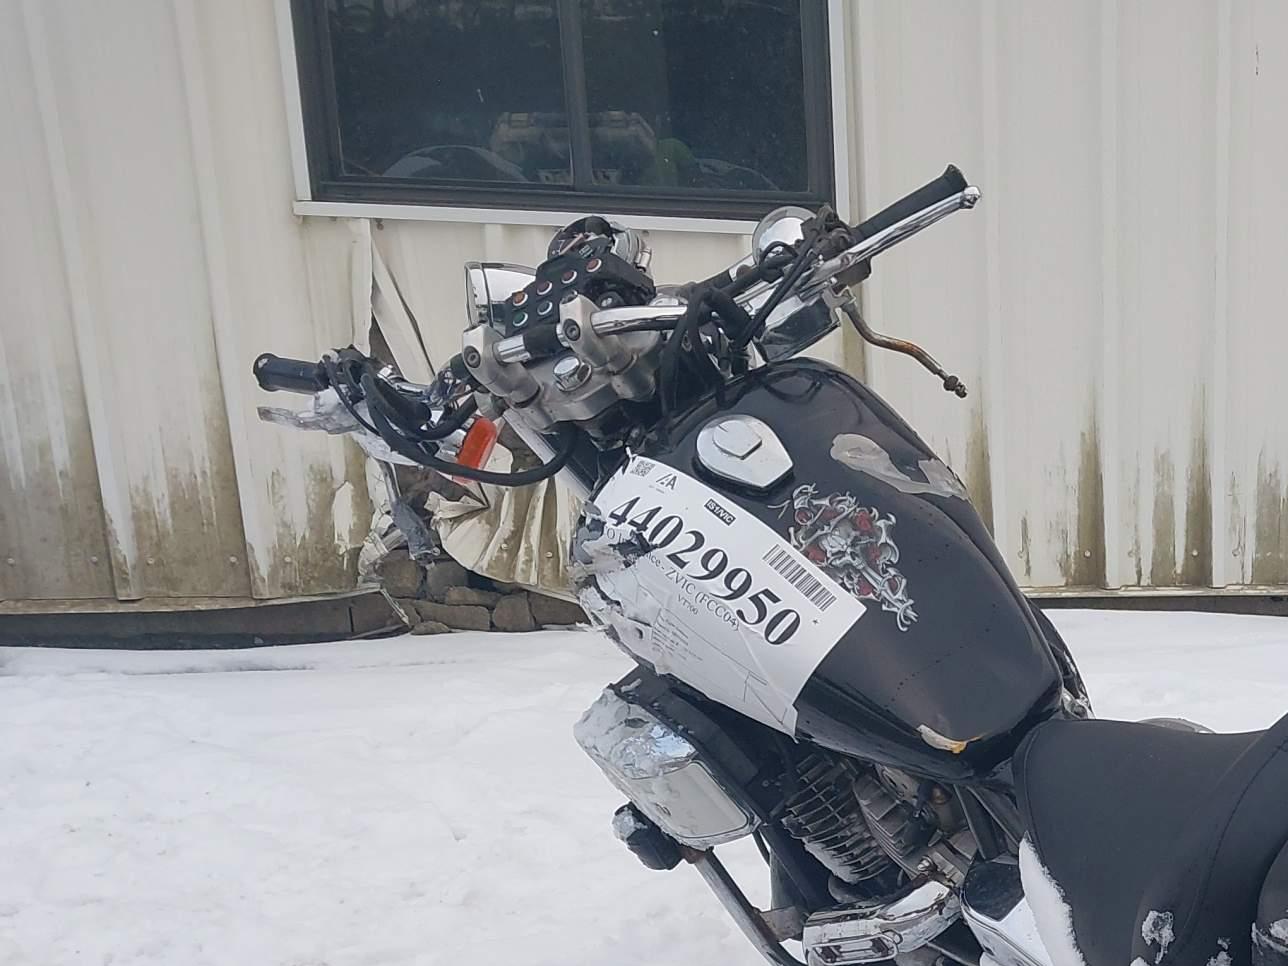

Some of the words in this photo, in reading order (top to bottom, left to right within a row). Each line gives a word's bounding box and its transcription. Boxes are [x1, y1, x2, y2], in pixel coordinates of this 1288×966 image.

[608, 495, 801, 646] 44029950
[666, 566, 696, 595] ZVIC
[694, 592, 741, 632] (FCC04)
